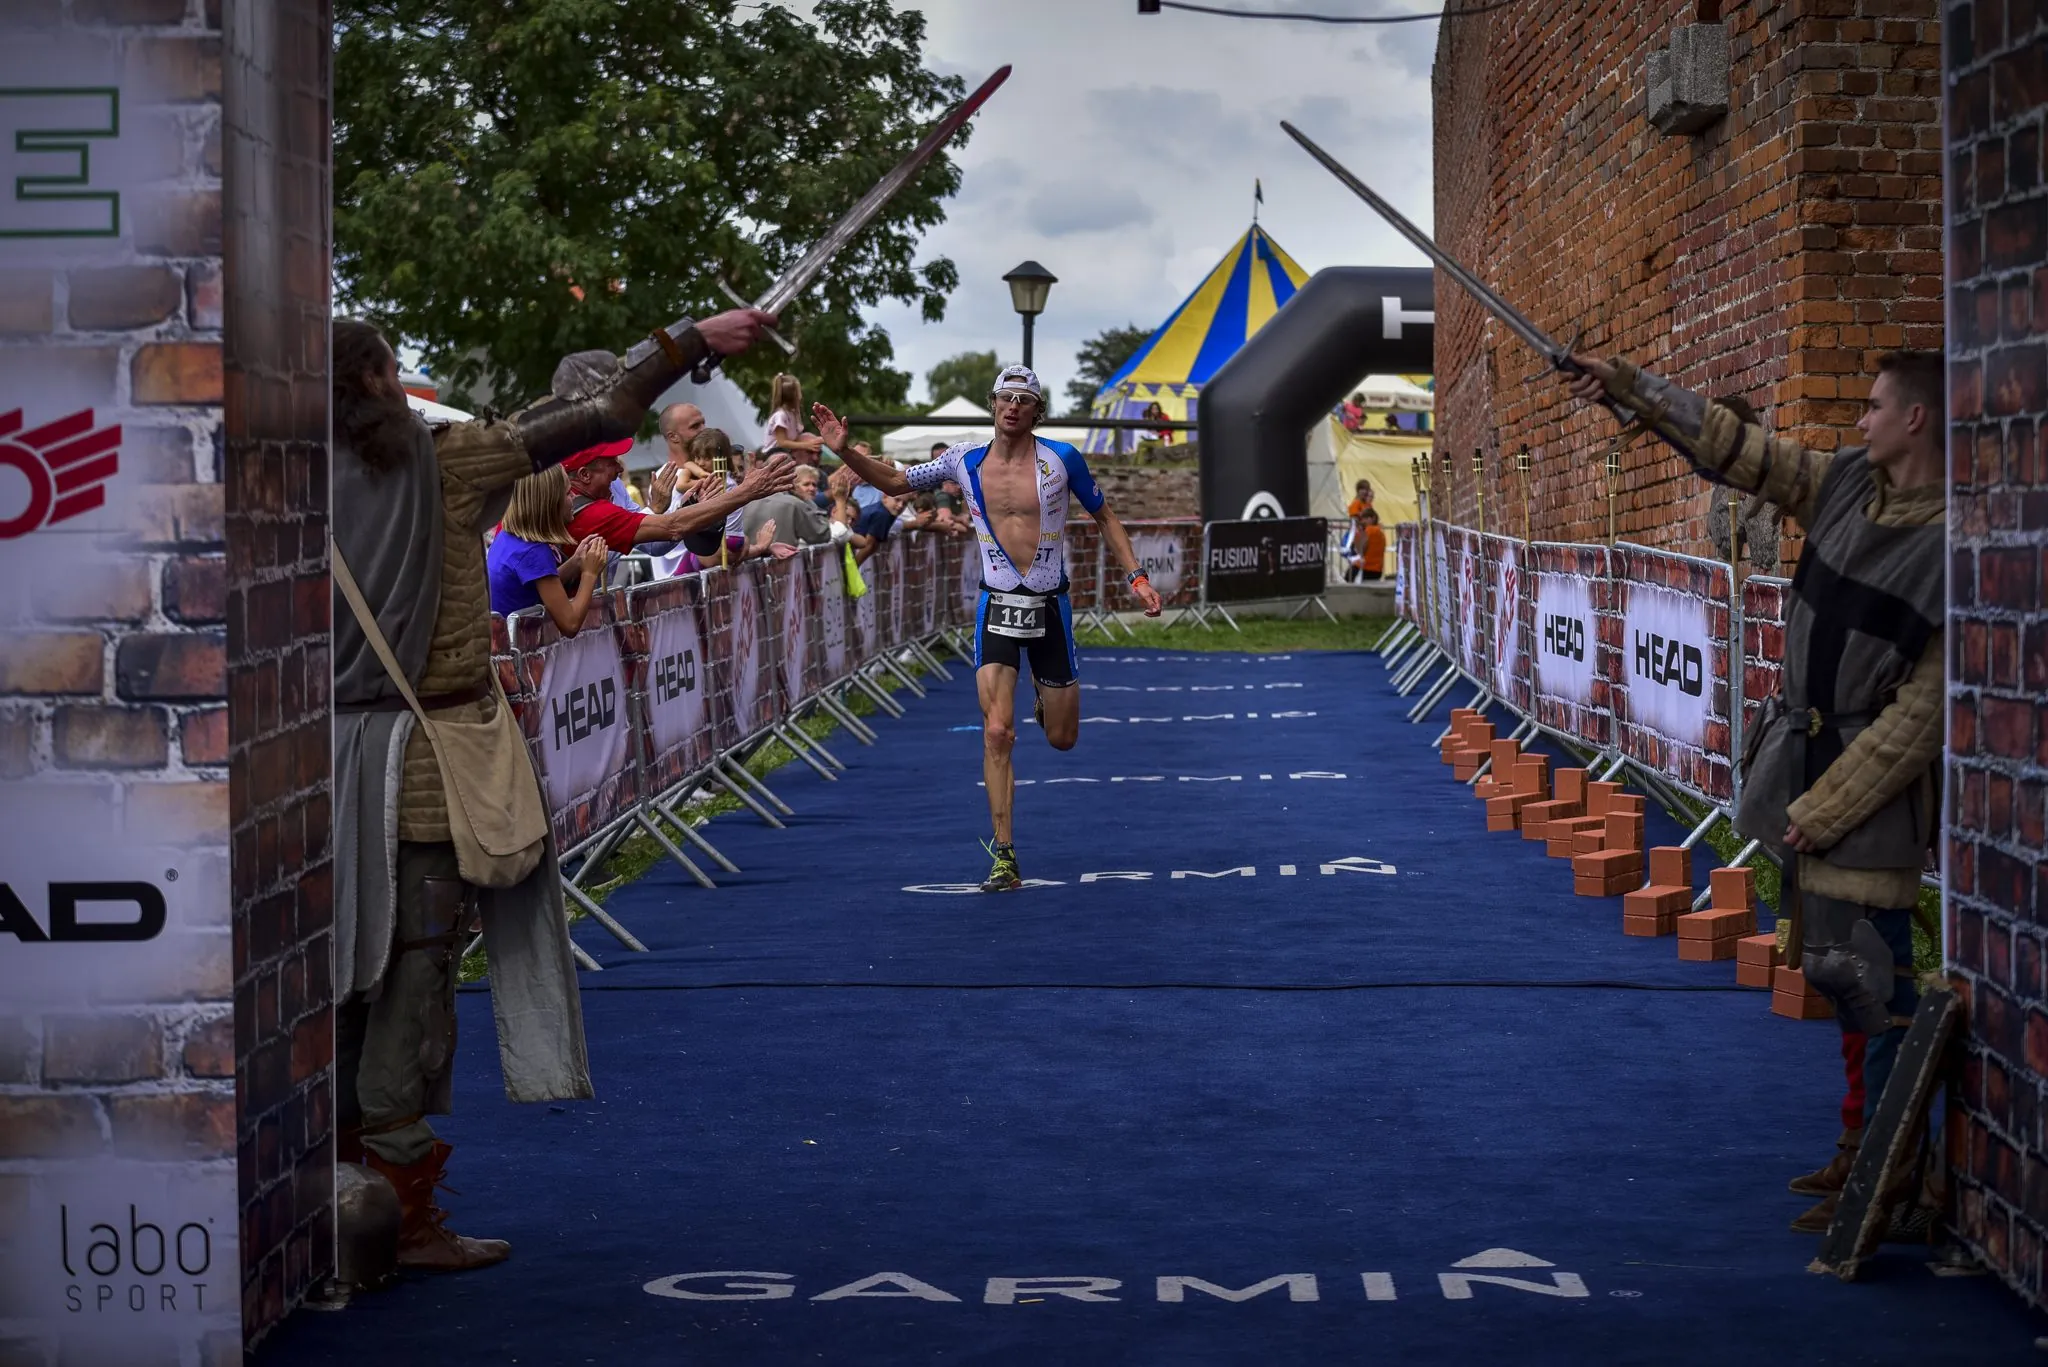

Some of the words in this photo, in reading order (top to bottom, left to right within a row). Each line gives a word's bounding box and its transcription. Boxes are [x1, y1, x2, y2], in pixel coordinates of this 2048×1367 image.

[1211, 547, 1259, 569] FUSION
[1280, 542, 1324, 564] FUSION
[1001, 607, 1036, 627] 114
[1544, 613, 1584, 663] HEAD
[655, 649, 695, 706] HEAD
[1635, 629, 1703, 698] HEAD
[551, 676, 617, 751] HEAD
[61, 1204, 211, 1277] labo
[66, 1284, 208, 1312] SPORT
[643, 1249, 1591, 1304] GARMIN
